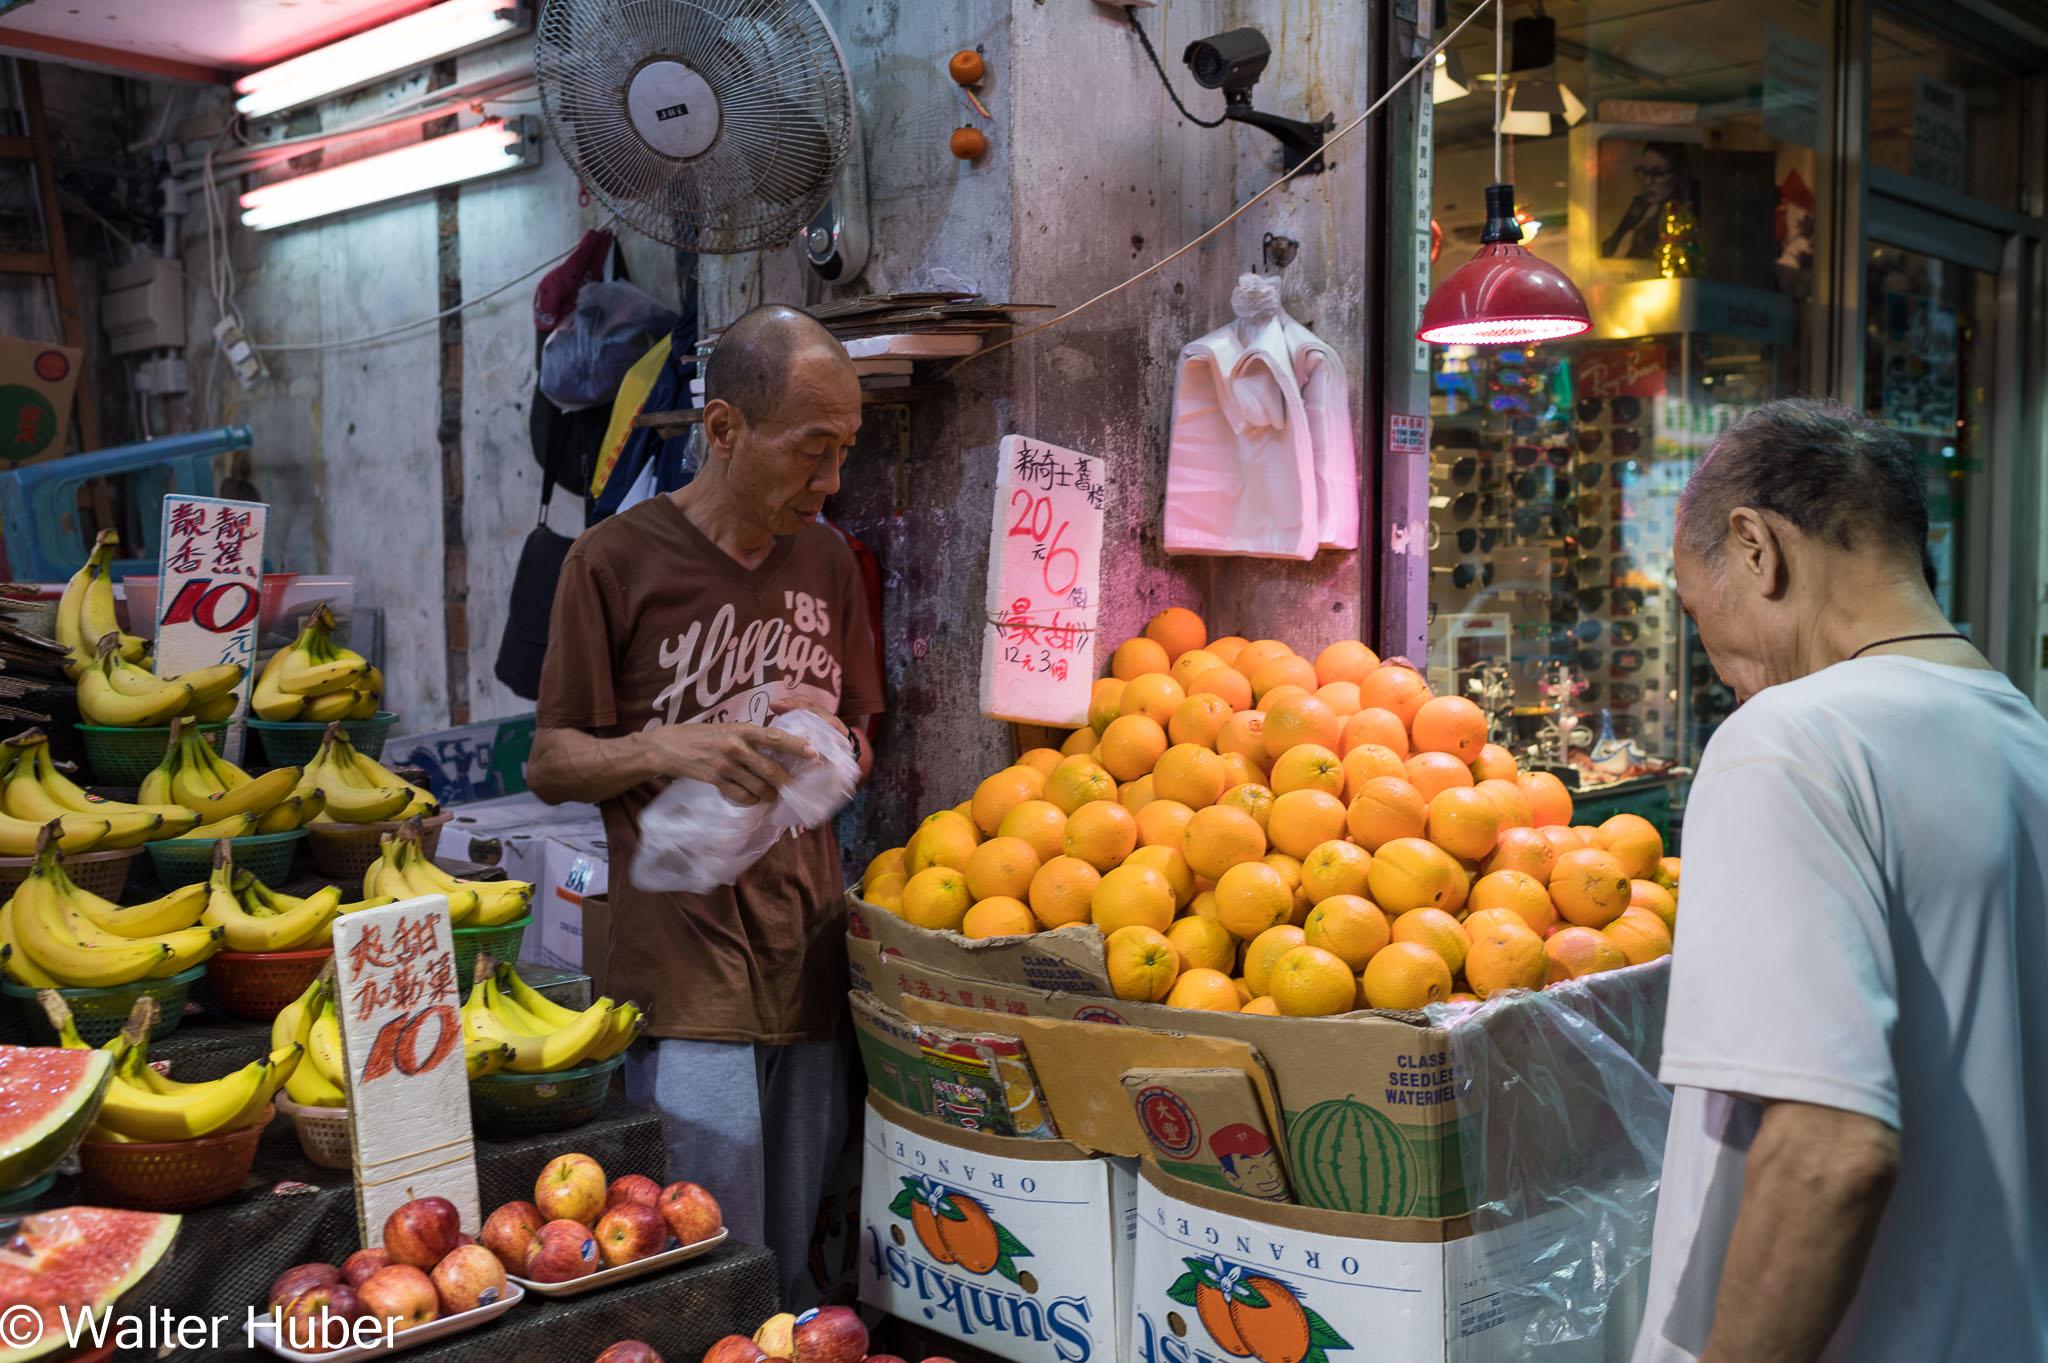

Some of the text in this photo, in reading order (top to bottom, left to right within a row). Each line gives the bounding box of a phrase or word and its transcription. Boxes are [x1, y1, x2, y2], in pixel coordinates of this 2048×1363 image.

[1008, 488, 1052, 542] 20
[160, 577, 261, 634] 10
[652, 603, 843, 725] Hilfiger
[358, 1005, 462, 1087] 10
[1397, 1051, 1447, 1069] CLASS
[879, 1132, 1037, 1194] ORANGES
[1156, 1207, 1360, 1276] ORANGES
[866, 1225, 1093, 1363] Sunkist
